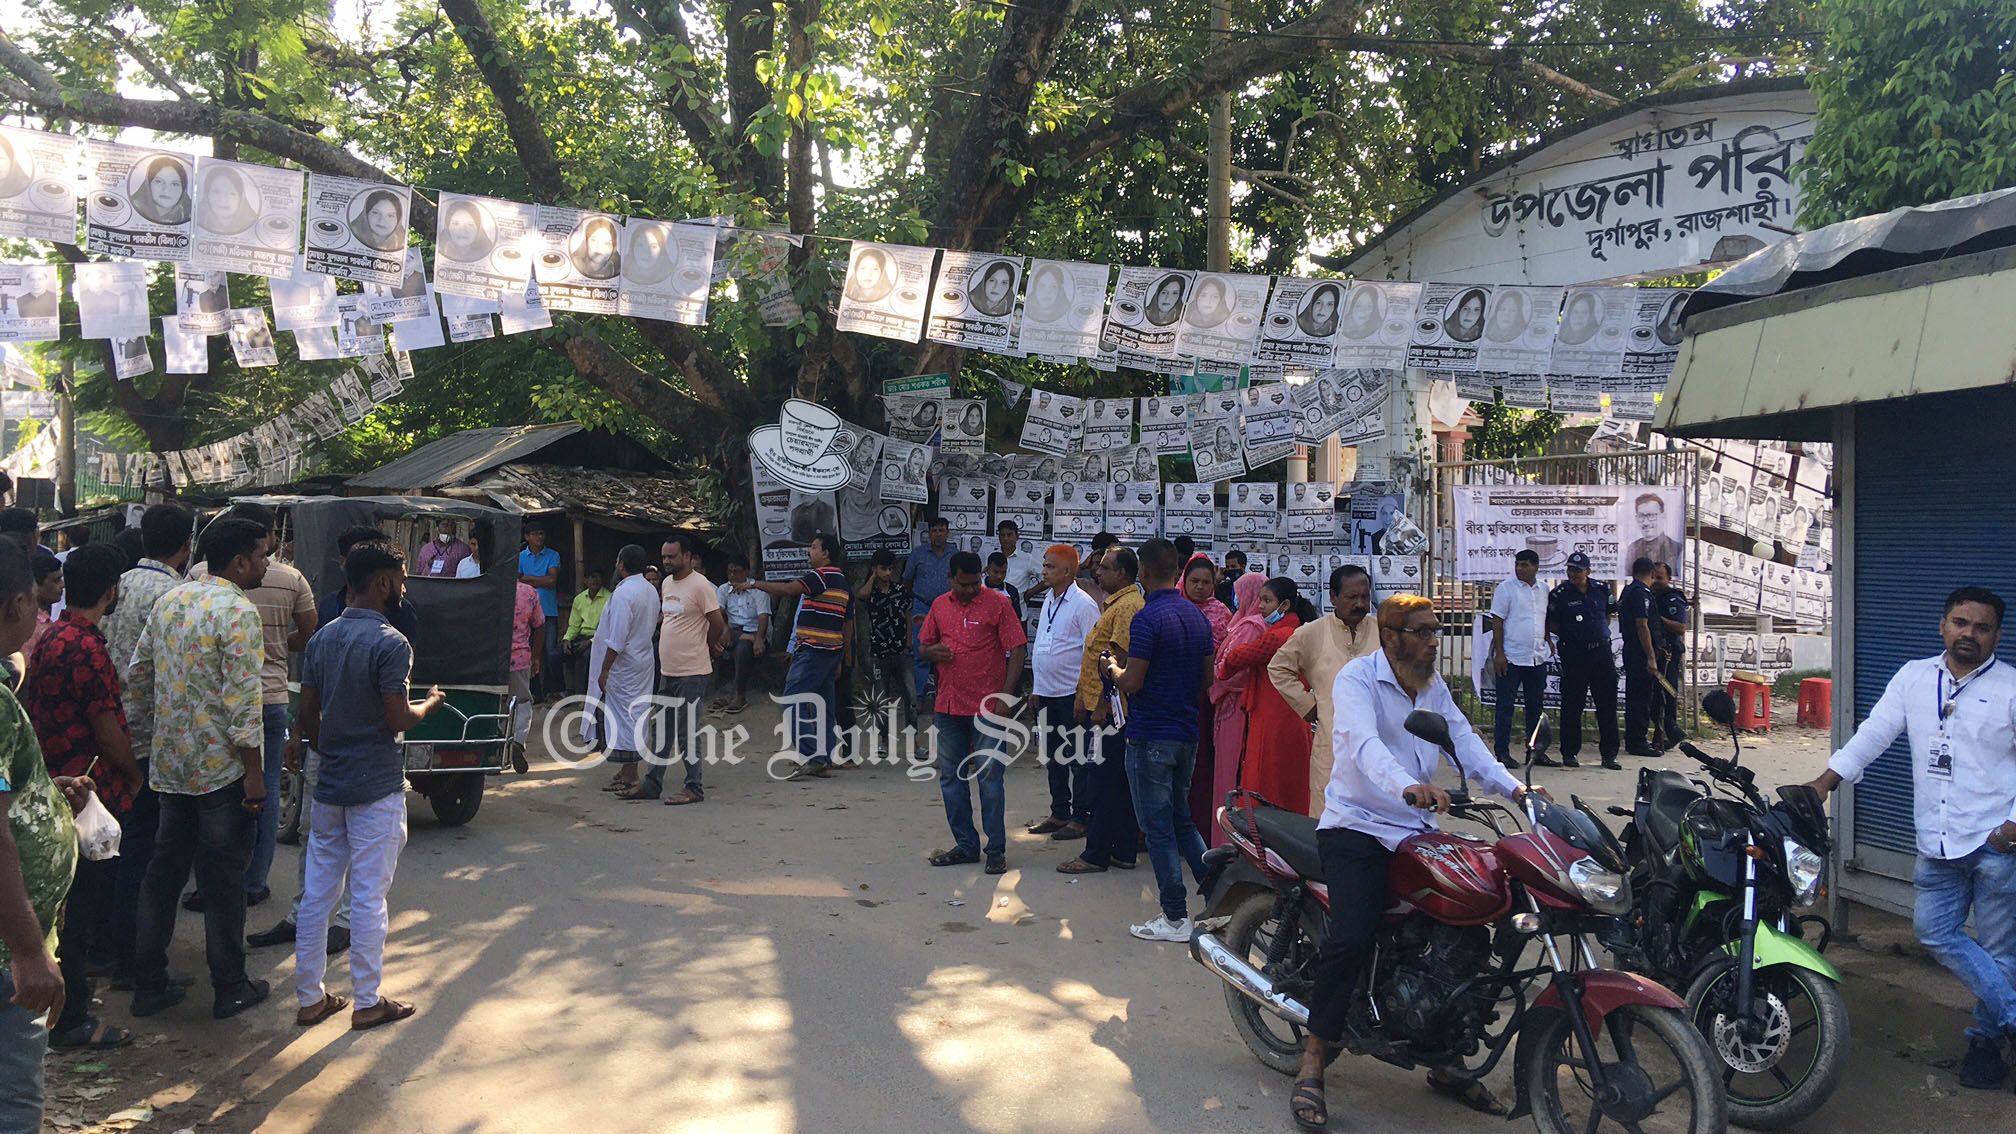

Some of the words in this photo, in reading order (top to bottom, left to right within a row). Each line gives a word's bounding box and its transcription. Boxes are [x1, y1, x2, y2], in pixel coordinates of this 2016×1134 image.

[1610, 117, 1718, 160] স্বাগতম
[1481, 156, 1674, 238] উপজেলা
[1586, 218, 1673, 261] দূর্গাপুর,
[1675, 188, 1791, 239] রাজশাহী।
[1491, 497, 1527, 505] বাংলাদেশ
[1529, 496, 1561, 505] আওয়ামী
[1511, 508, 1562, 516] চেয়ারম্যান
[1564, 507, 1595, 516] পদপ্রার্থী
[1465, 520, 1484, 535] বীর
[1487, 520, 1538, 537] মুক্তিযোদ্ধা
[1540, 520, 1560, 534] মীর
[1563, 521, 1600, 535] ইকবাল
[1602, 524, 1617, 534] কে
[1480, 546, 1498, 559] পিরিচ
[1573, 540, 1596, 554] ভোট
[1597, 539, 1619, 554] দিয়ে
